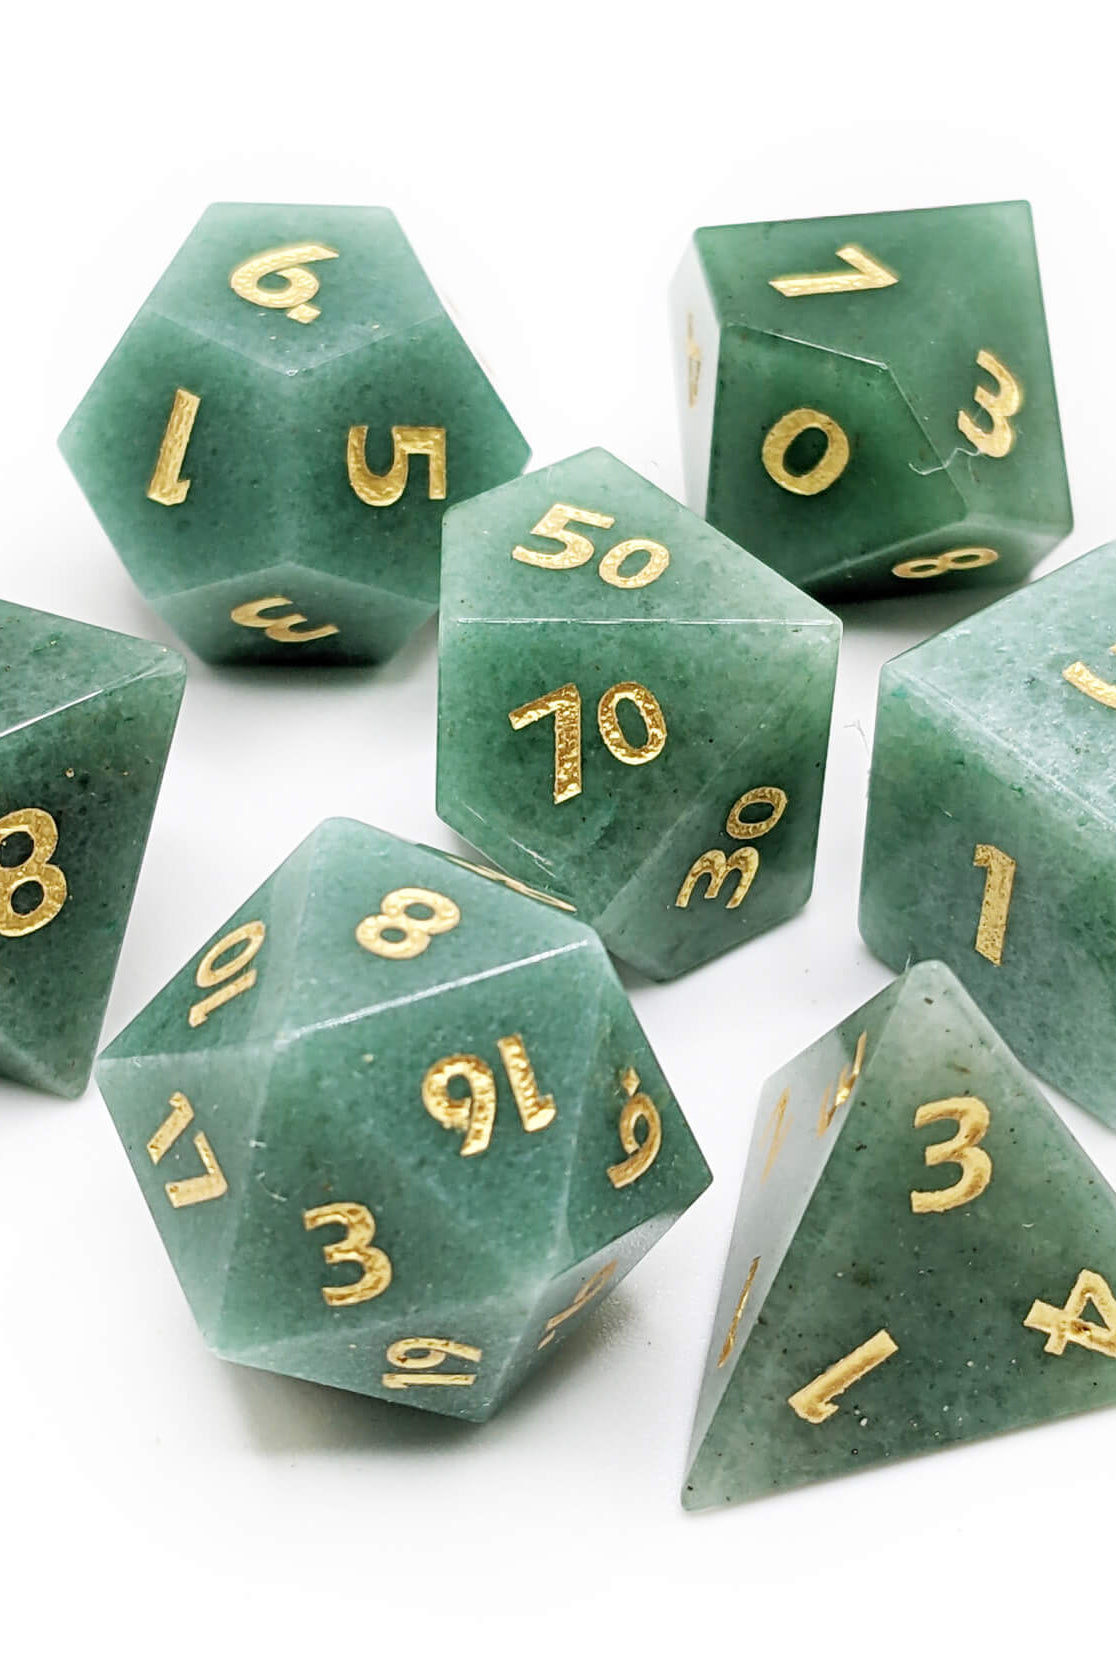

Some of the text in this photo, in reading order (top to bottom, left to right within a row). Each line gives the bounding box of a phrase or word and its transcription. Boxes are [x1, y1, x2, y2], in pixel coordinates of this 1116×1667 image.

[146, 388, 201, 506] 1
[762, 407, 850, 495] 0
[958, 349, 1023, 458] 3
[347, 425, 447, 507] 5
[512, 504, 670, 589] 50
[892, 547, 999, 579] 8
[230, 596, 340, 643] 3
[508, 681, 667, 804] 70
[0, 808, 68, 938] 8
[675, 787, 788, 909] 30
[355, 887, 461, 960] 8
[973, 844, 1018, 967] 1
[188, 920, 266, 1027] 10
[422, 1034, 557, 1157] 16
[146, 1092, 228, 1209] 17
[910, 1096, 995, 1214] 3
[303, 1202, 393, 1307] 3
[1023, 1268, 1116, 1360] 4
[787, 1329, 900, 1425] 1
